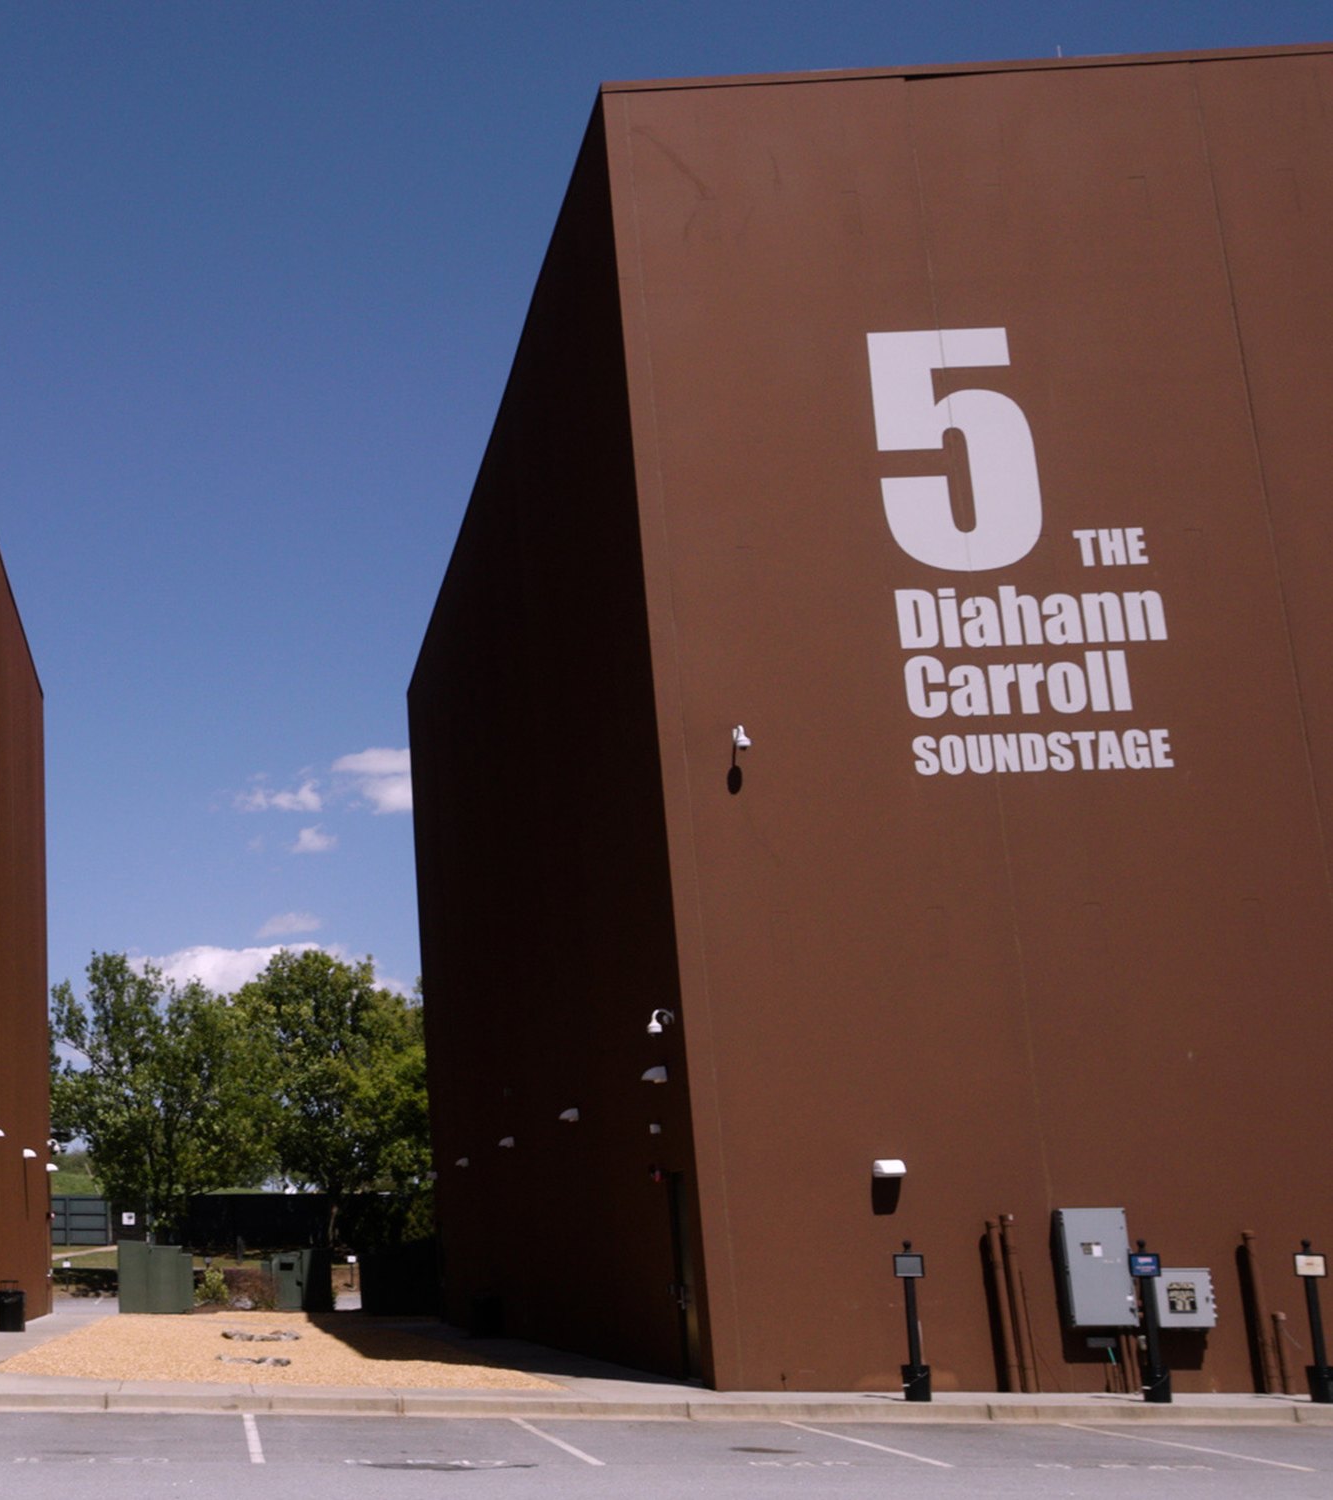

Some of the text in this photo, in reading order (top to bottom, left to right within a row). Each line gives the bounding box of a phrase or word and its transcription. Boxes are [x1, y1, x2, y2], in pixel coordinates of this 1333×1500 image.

[866, 327, 1043, 572] 5
[1072, 527, 1149, 567] THE
[894, 585, 1168, 650] Diahann
[903, 650, 1133, 719] Carroll
[912, 728, 1174, 776] SOUNDSTAGE
